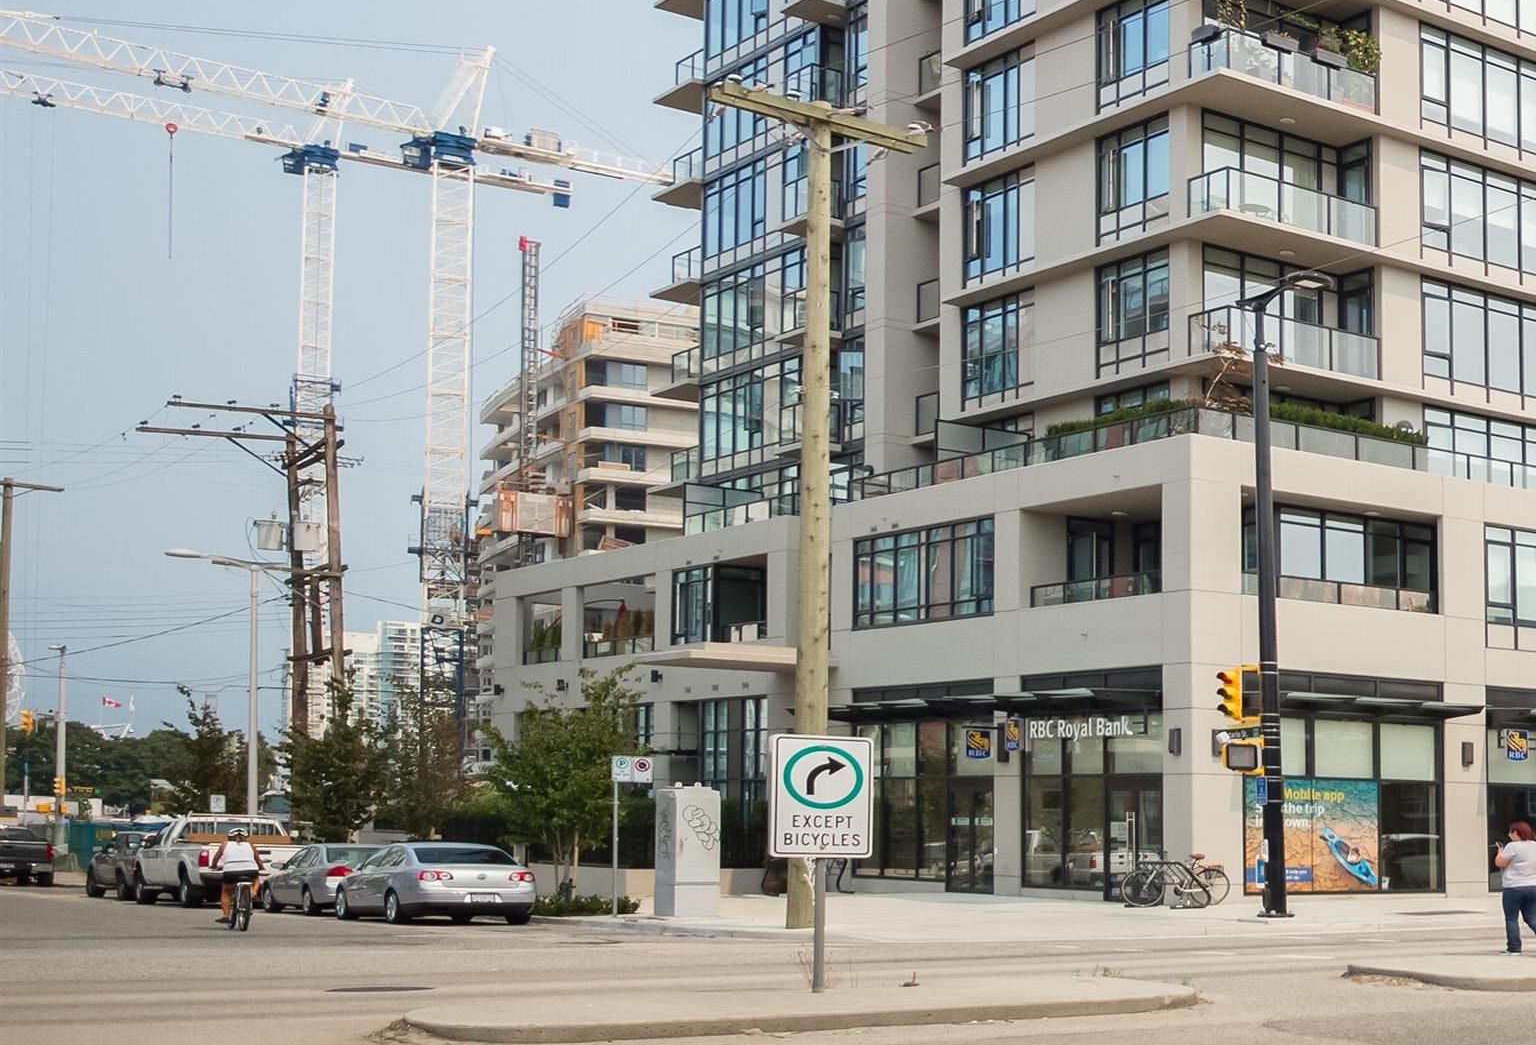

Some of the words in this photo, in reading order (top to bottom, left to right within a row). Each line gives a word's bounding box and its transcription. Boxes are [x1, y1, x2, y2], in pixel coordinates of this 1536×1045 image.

[1029, 719, 1053, 739] RBC
[1057, 717, 1093, 742] Royal
[1096, 715, 1132, 736] Bank
[1007, 741, 1019, 749] RBC
[968, 749, 988, 757] RBC
[1508, 751, 1526, 759] RBC
[1283, 788, 1322, 801] Mobile
[1323, 791, 1345, 802] app
[1284, 802, 1303, 814] the
[1304, 803, 1325, 817] trip
[792, 814, 853, 829] EXCEPT
[1283, 817, 1312, 828] own.
[783, 832, 861, 847] BICYCLES
